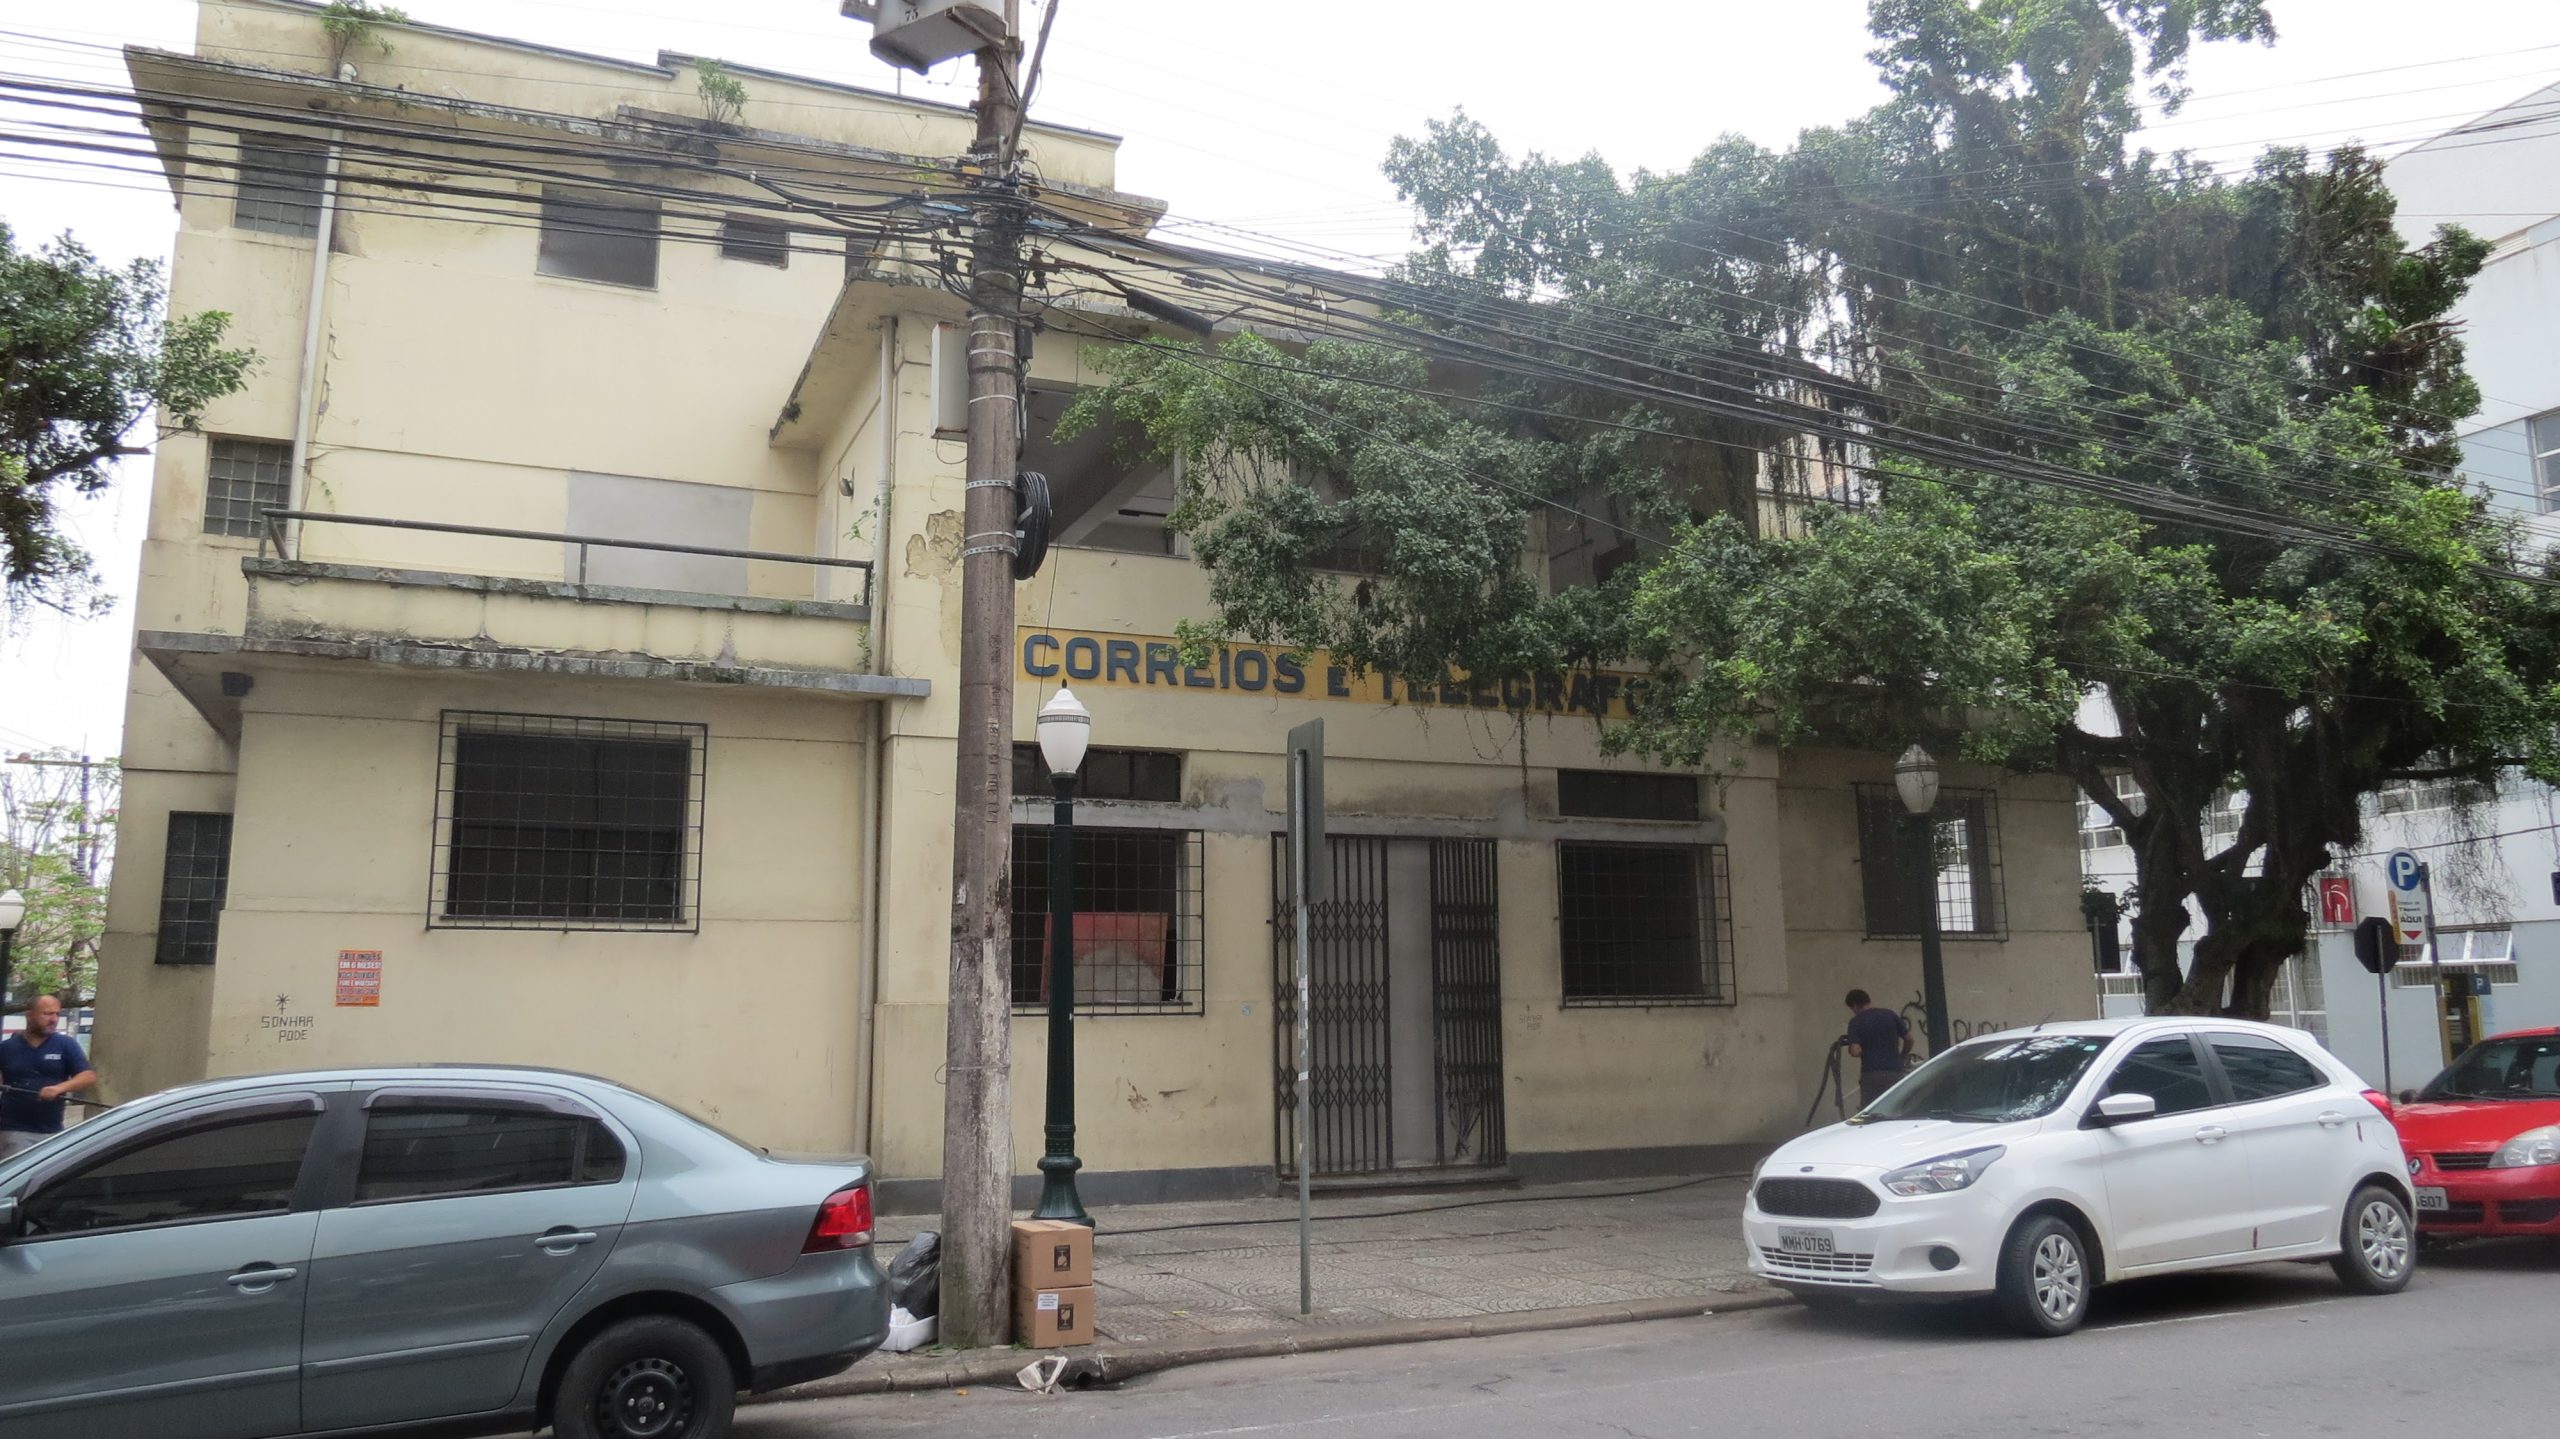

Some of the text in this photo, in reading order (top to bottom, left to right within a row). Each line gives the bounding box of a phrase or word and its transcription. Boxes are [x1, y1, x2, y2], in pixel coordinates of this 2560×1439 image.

[1024, 633, 1662, 717] CORREIOS E TELEGRAFO
[2395, 856, 2415, 886] P
[2476, 977, 2484, 990] P
[261, 1016, 314, 1028] SONHAR
[278, 1029, 308, 1043] PODE
[2416, 1195, 2442, 1208] 607
